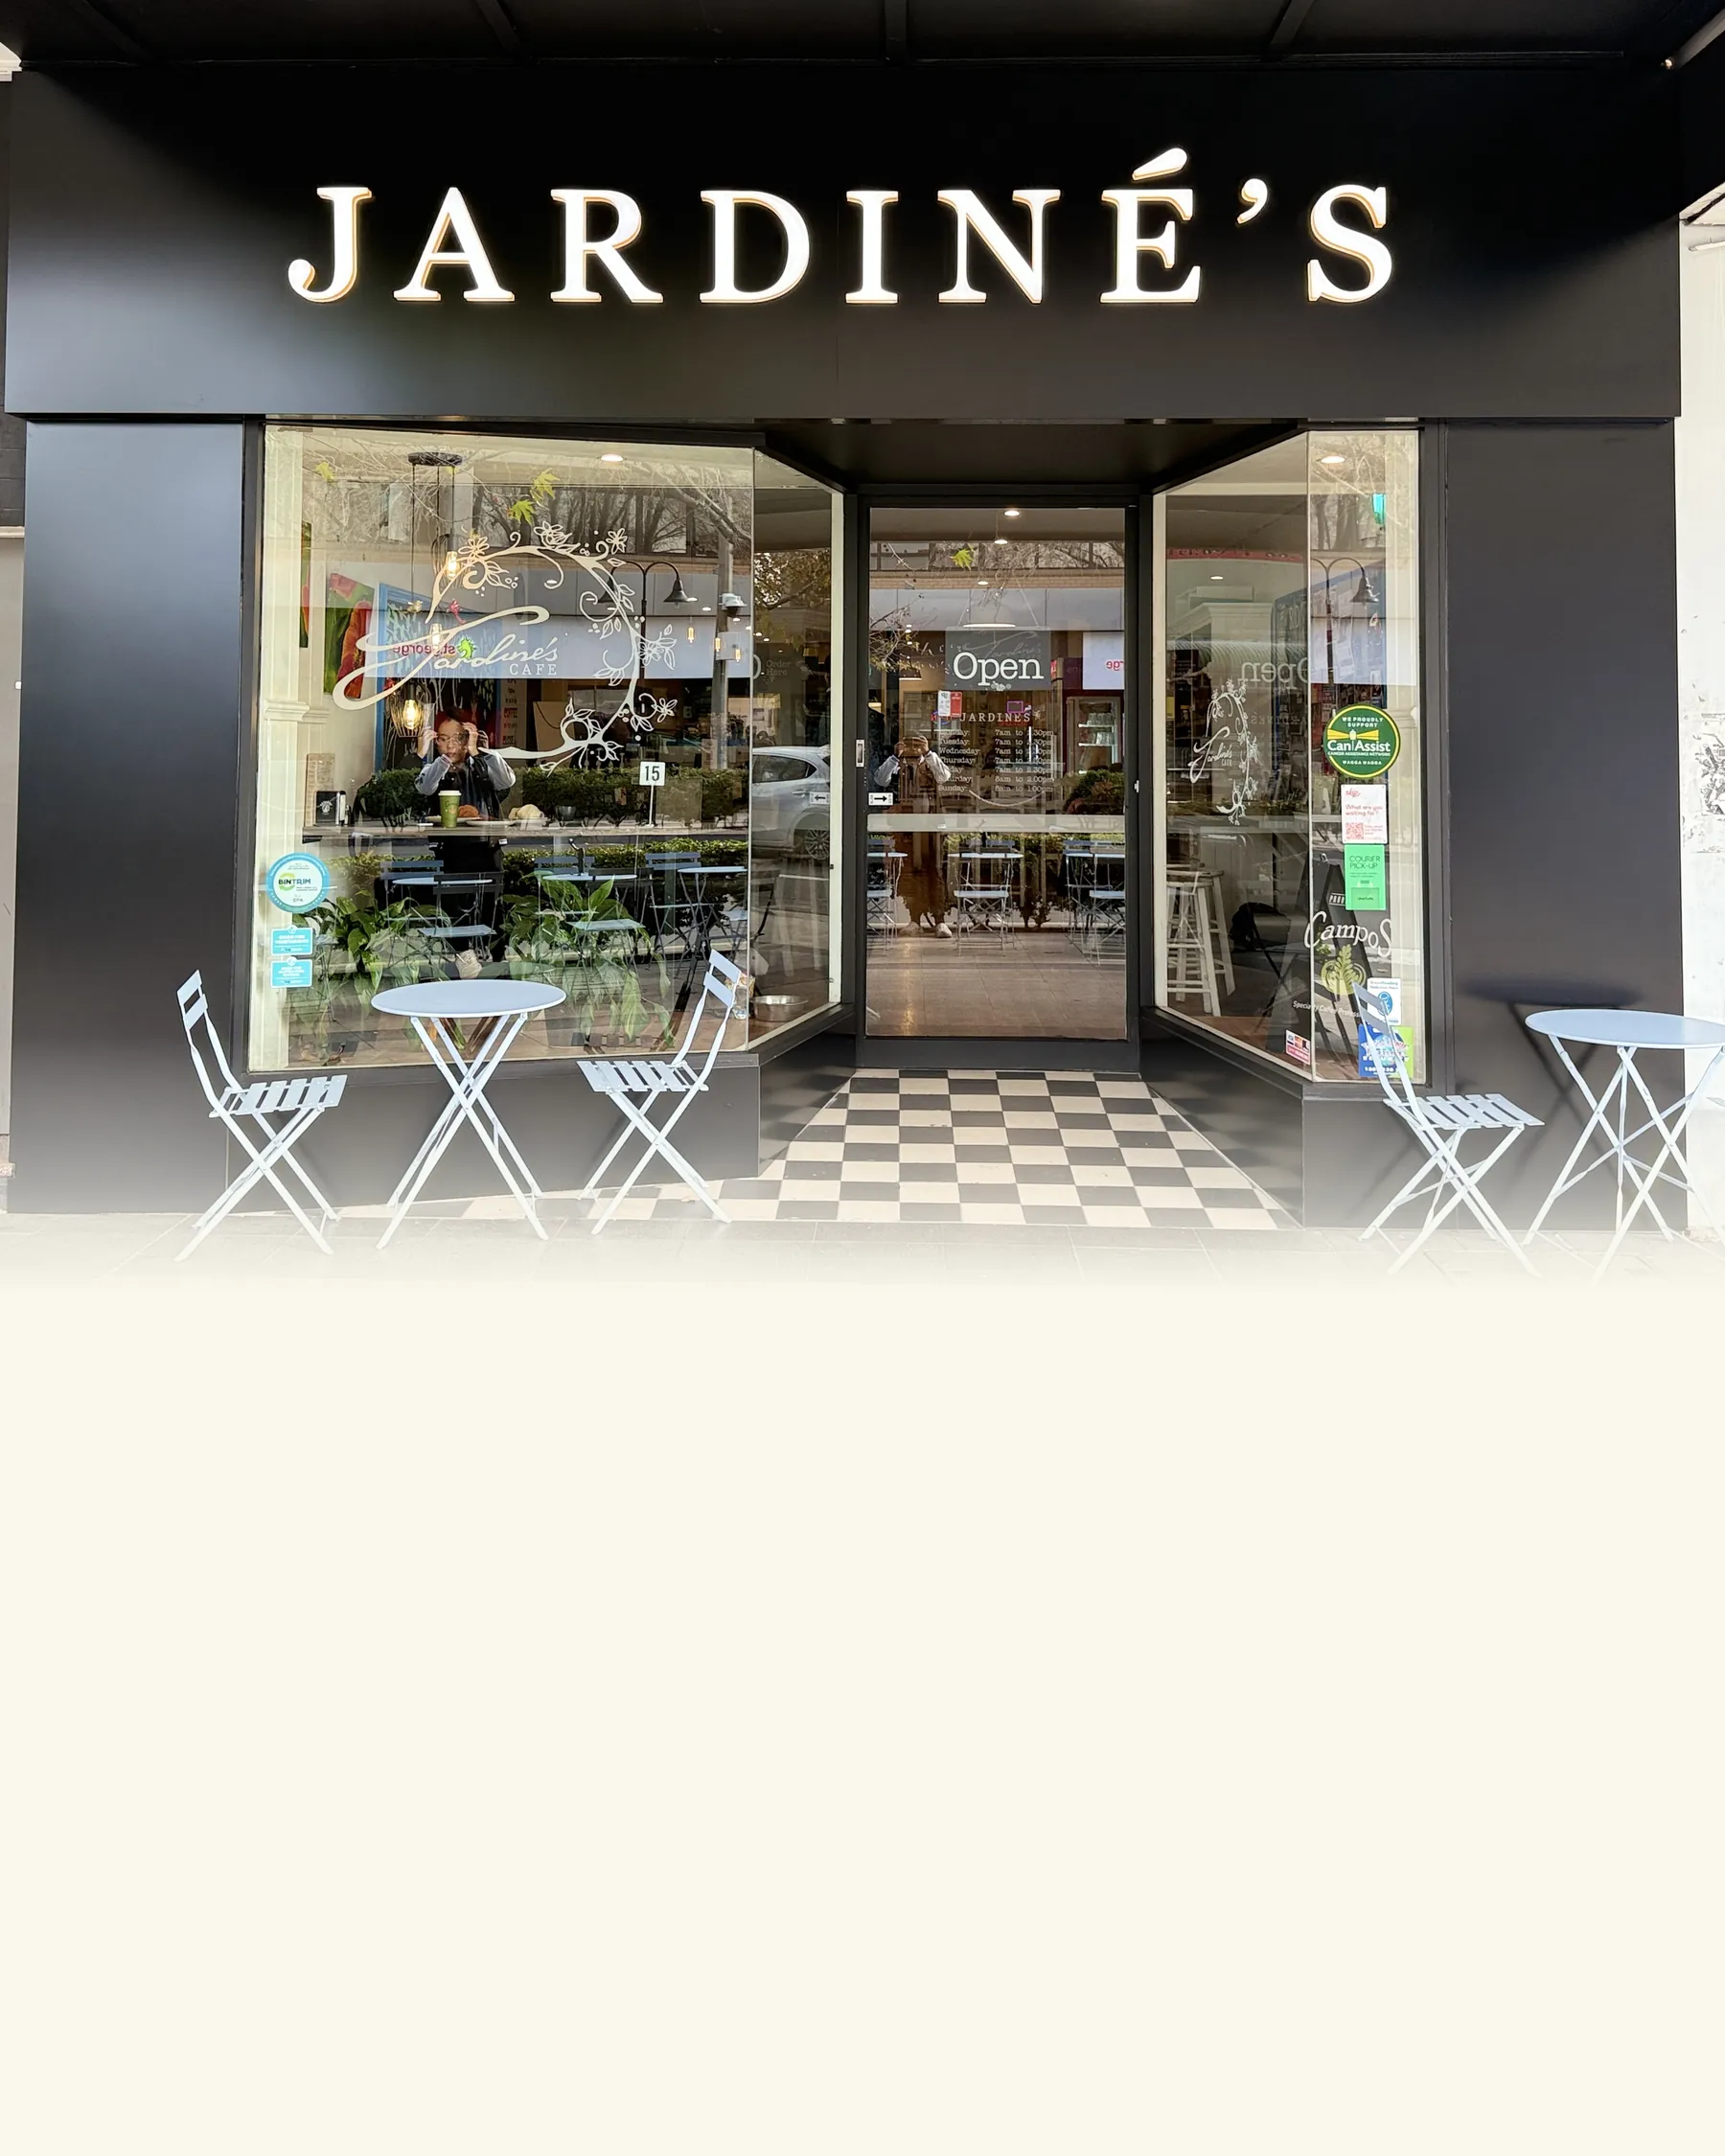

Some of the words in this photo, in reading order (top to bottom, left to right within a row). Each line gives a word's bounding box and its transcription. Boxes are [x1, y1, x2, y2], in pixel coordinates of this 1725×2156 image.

[509, 663, 558, 676] CAFE
[954, 652, 1044, 686] Open
[645, 766, 659, 781] 15
